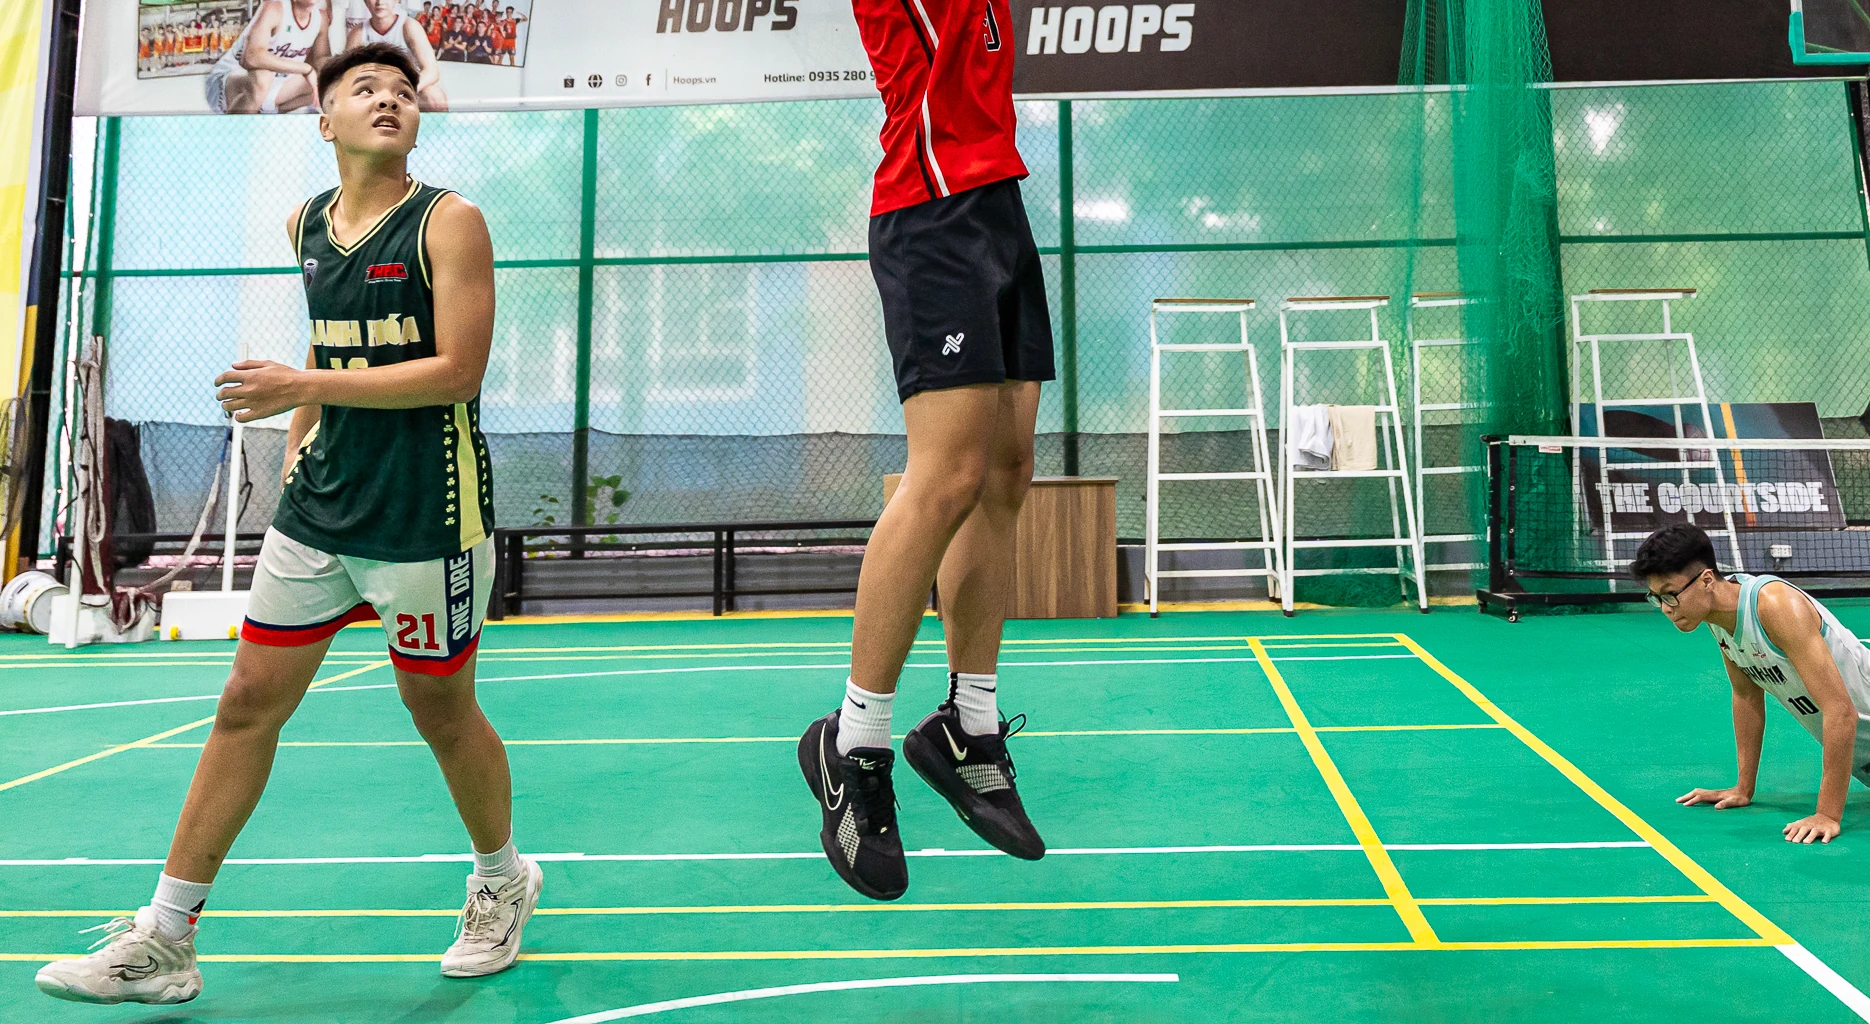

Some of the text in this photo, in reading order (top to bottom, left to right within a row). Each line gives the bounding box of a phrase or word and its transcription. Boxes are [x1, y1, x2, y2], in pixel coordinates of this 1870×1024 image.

[1026, 3, 1195, 55] HOOPS
[673, 75, 717, 86] Hoops.vn
[764, 73, 805, 83] Hotline:
[808, 70, 840, 82] 0935
[842, 70, 867, 81] 280
[366, 313, 421, 347] HÓA
[1595, 481, 1829, 513] THE COURTSIDE
[396, 612, 440, 651] 21
[451, 596, 470, 640] ONE
[1787, 695, 1819, 715] 10
